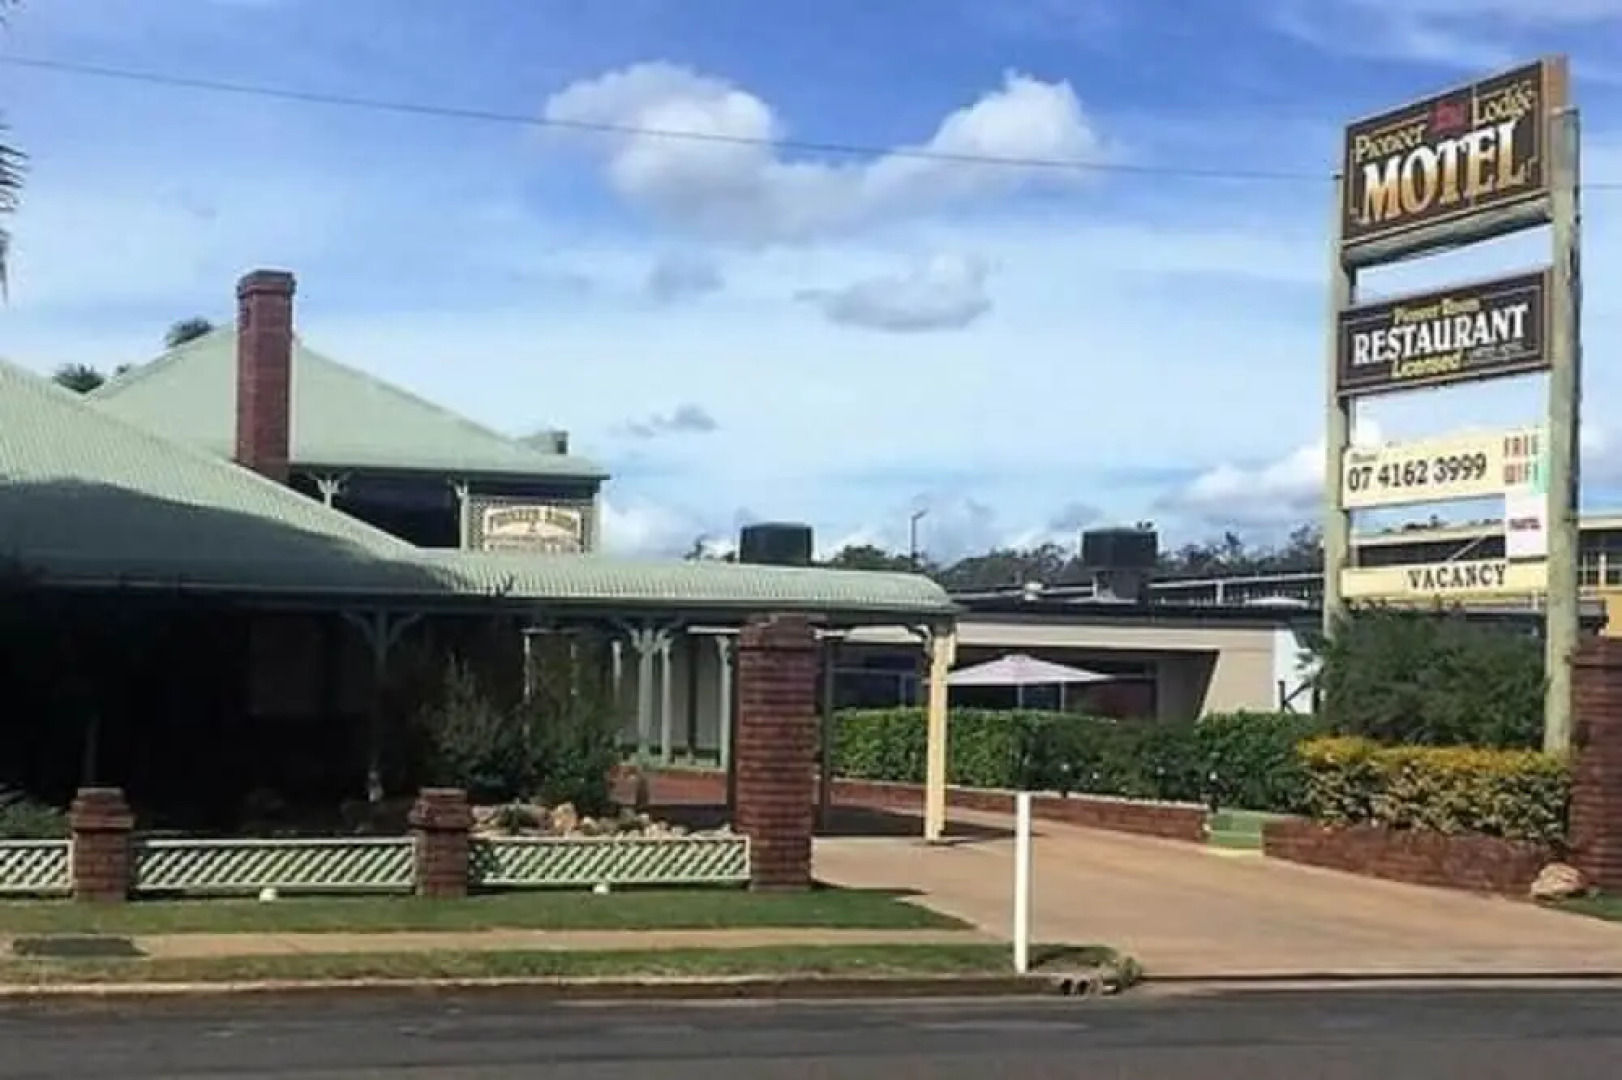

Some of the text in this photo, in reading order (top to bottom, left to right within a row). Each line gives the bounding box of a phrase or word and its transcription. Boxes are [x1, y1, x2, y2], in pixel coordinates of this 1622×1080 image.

[1364, 121, 1524, 223] MOTEL
[1352, 304, 1527, 366] RESTAURANT
[1348, 453, 1487, 491] 07 4162 3999
[1408, 564, 1506, 588] VACANCY
